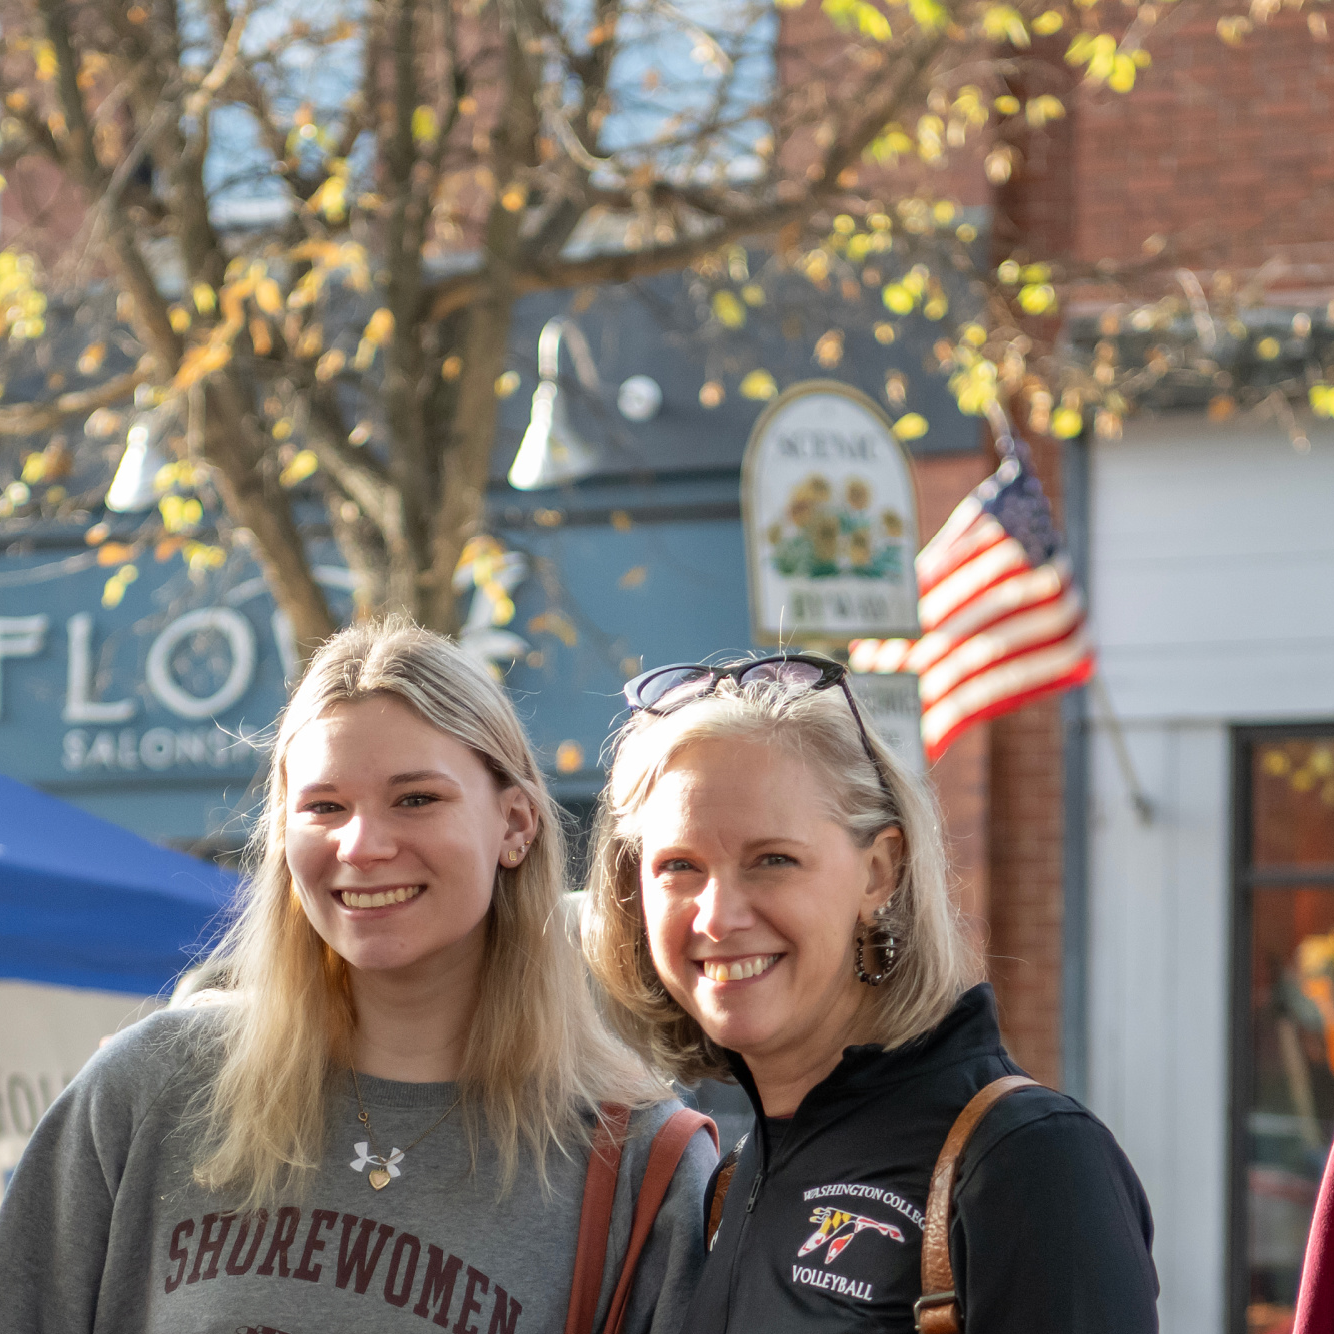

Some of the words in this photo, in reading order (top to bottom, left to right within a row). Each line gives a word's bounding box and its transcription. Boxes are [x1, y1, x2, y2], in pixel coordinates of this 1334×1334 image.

[803, 1183, 884, 1202] WASHINGTON
[882, 1192, 926, 1232] COLLEG
[792, 1264, 873, 1301] VOLLEYBALL
